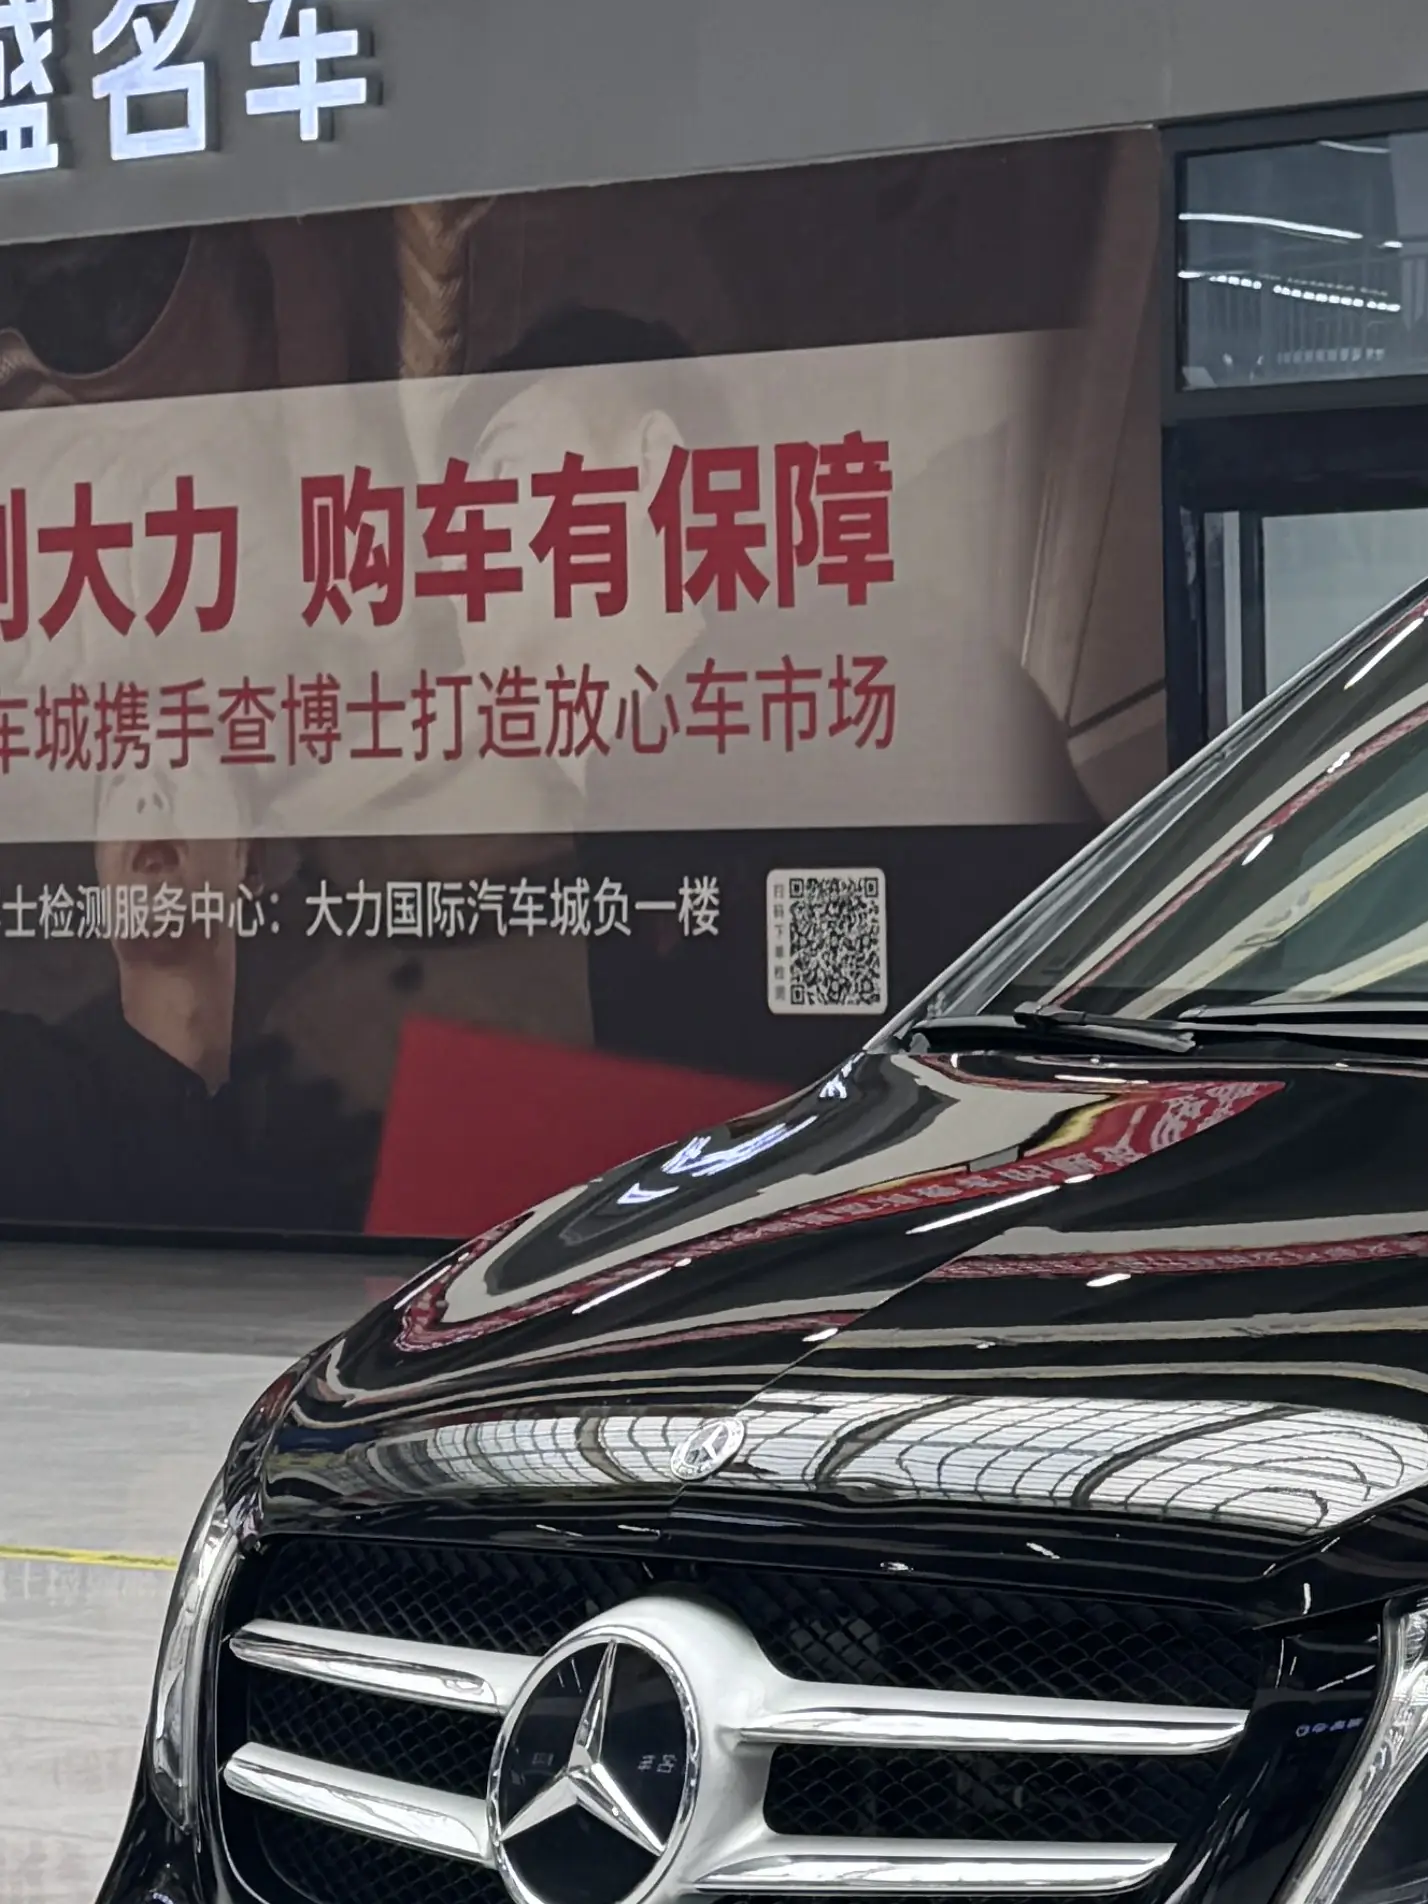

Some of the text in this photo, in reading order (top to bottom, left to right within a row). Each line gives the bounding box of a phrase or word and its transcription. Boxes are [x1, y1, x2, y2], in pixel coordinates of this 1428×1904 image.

[300, 428, 894, 628] 购车有保障
